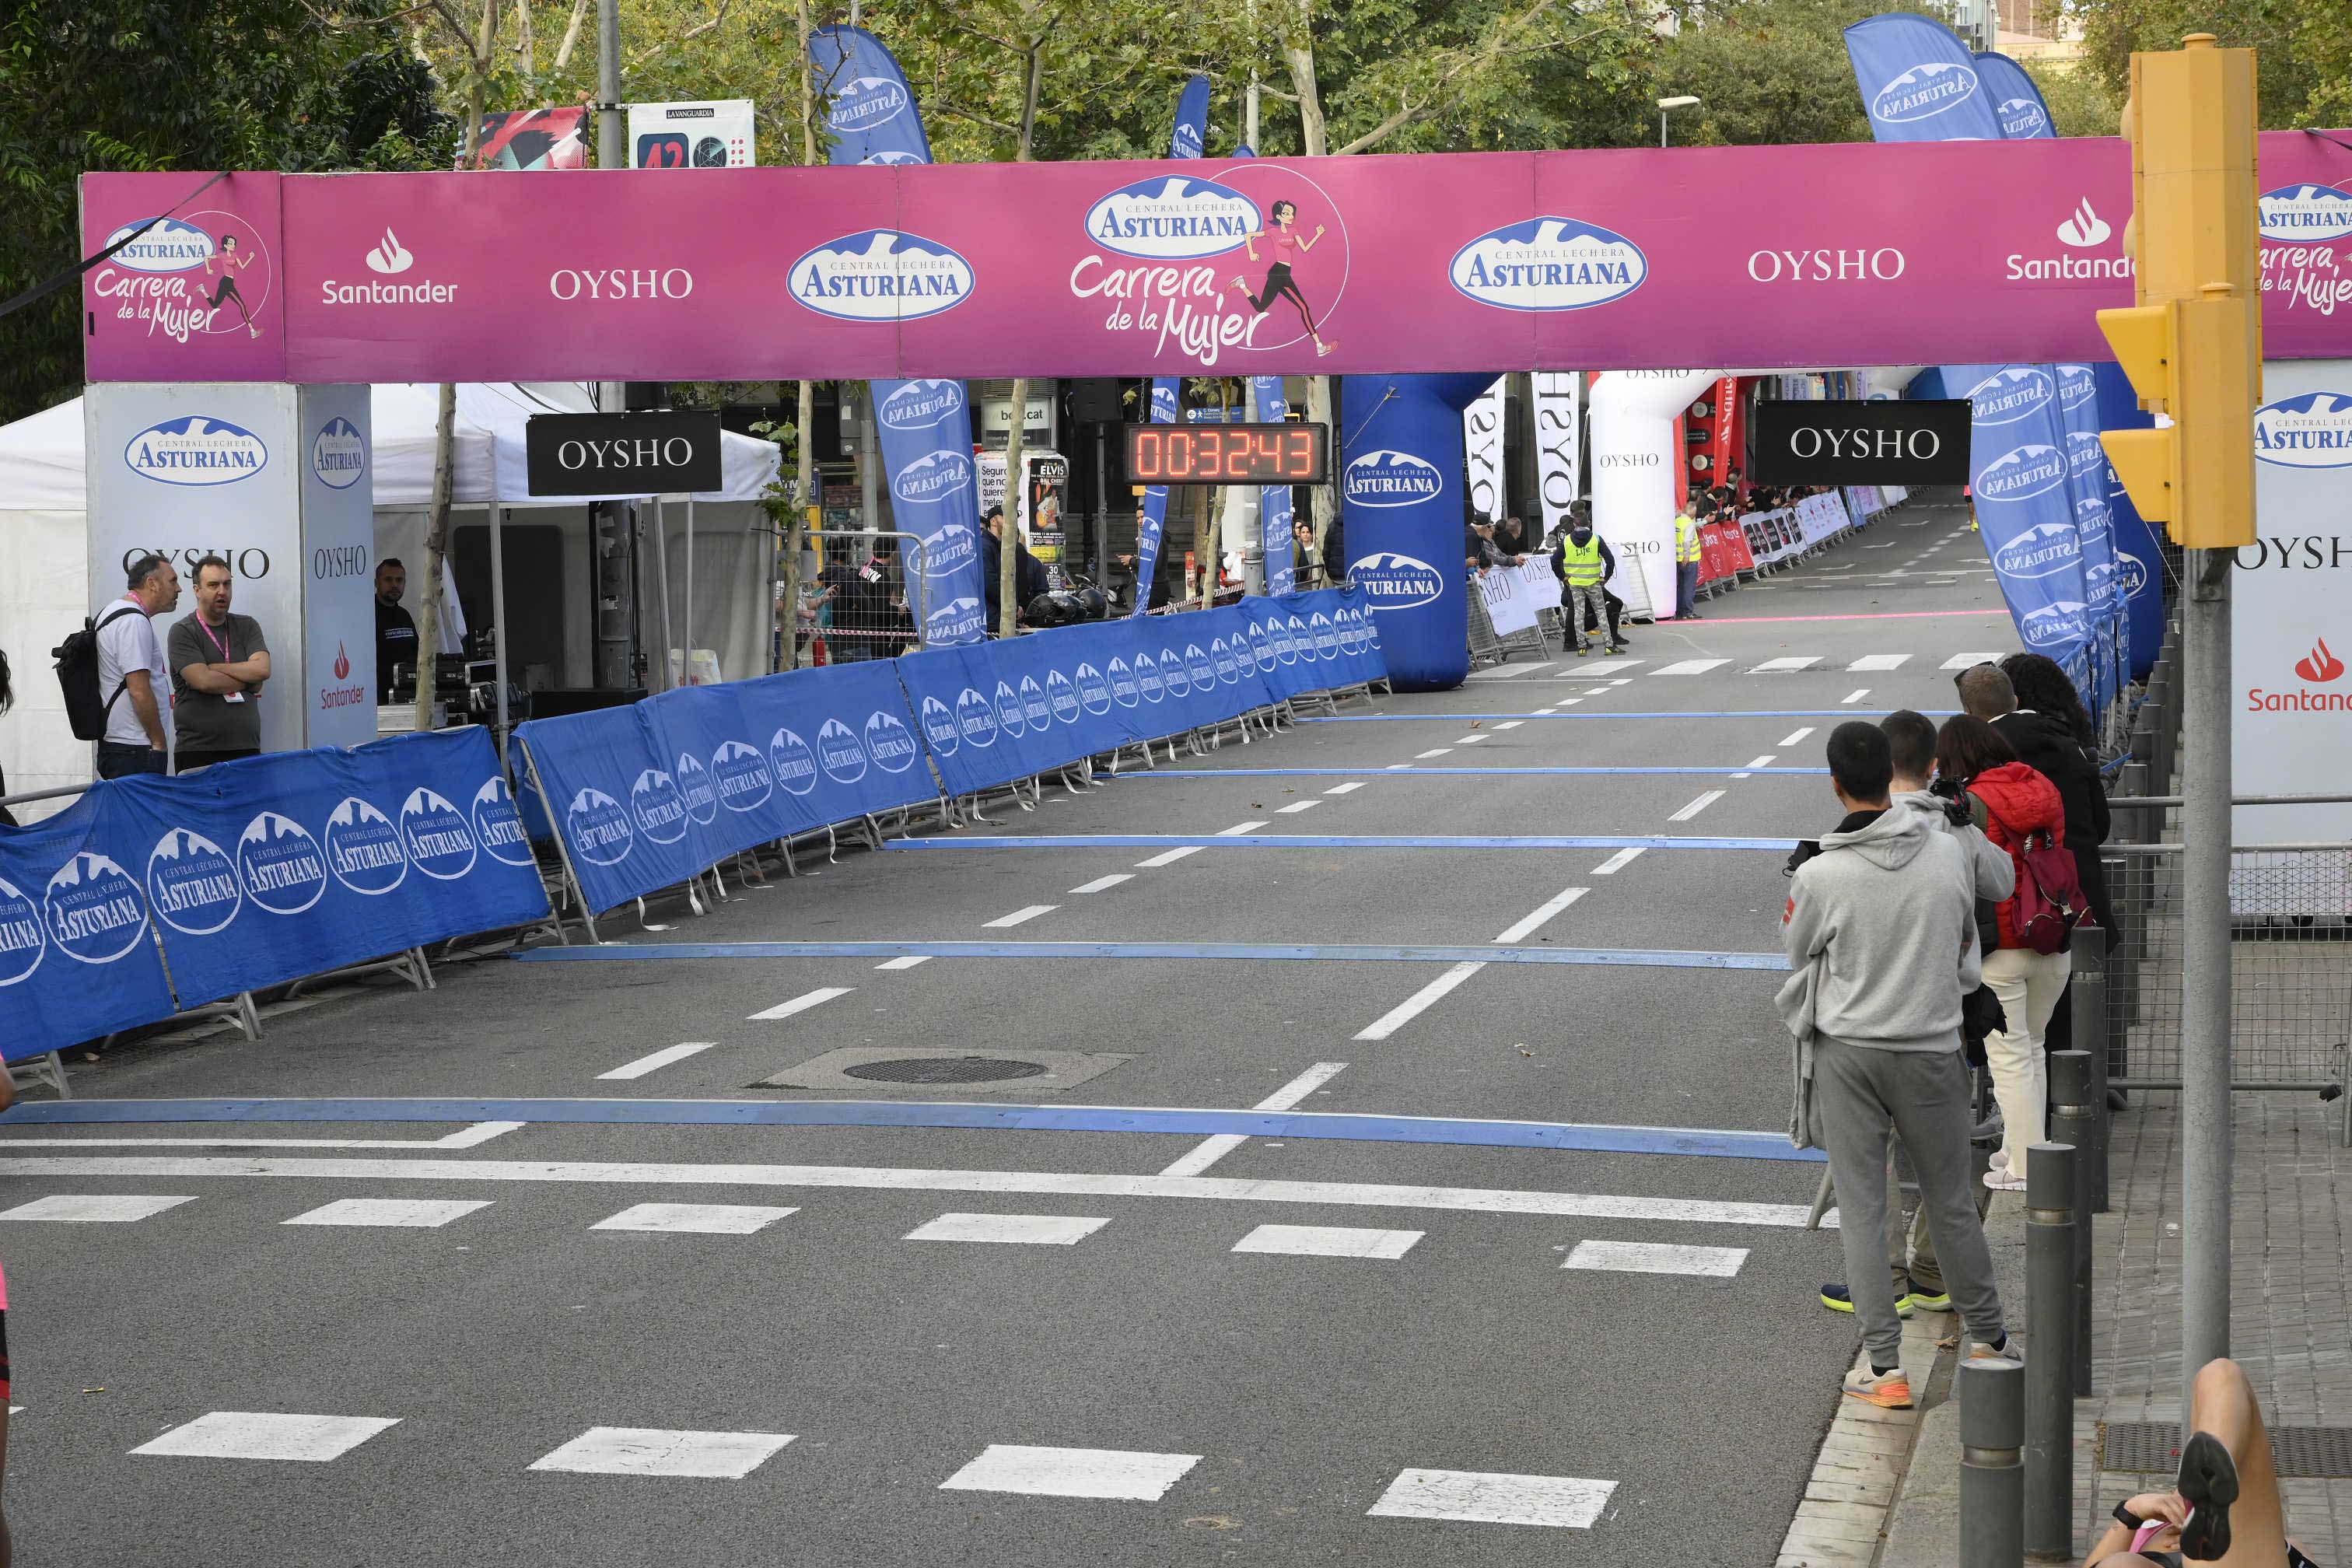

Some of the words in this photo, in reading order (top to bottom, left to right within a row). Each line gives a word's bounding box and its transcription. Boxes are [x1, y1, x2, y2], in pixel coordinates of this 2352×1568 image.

[1099, 207, 1247, 238] ASTURIANA
[1125, 205, 1183, 213] CENTRAL
[114, 236, 206, 258] ASTURIANA
[1495, 250, 1556, 259] CENTRAL
[1563, 249, 1625, 257] LECHERA
[2259, 247, 2334, 269] arrera
[831, 261, 889, 271] CENTRAL
[895, 261, 954, 270] LECHERA
[1069, 254, 1215, 299] Carrera
[1465, 254, 1632, 287] ASTURIANA
[1748, 247, 1905, 282] OYSHO
[2007, 254, 2136, 280] Santand
[94, 268, 186, 298] Carrera
[322, 279, 457, 304] Santander
[550, 268, 693, 300] OYSHO
[802, 264, 961, 297] ASTURIANA
[2277, 270, 2291, 291] la
[2288, 264, 2352, 316] Muje
[117, 299, 134, 319] de
[138, 299, 150, 320] la
[148, 295, 221, 343] Mujer
[1106, 301, 1132, 331] de
[1139, 299, 1158, 331] la
[1154, 292, 1270, 366] Mujer
[2255, 422, 2352, 450] ASTURIA
[2276, 418, 2329, 427] CENTRAL
[136, 442, 258, 468] ASTURIANA
[558, 437, 693, 470] OYSHO
[1138, 432, 1311, 476] 00:32:43
[1790, 427, 1940, 460] OYSHO
[317, 444, 362, 471] ASTURIANA
[1040, 465, 1064, 475] ELVIS
[1600, 453, 1659, 468] OYSHO
[982, 478, 994, 487] que
[1347, 473, 1435, 495] ASTURIANA
[1624, 541, 1661, 555] SHO
[2233, 536, 2352, 570] OYSH
[314, 545, 366, 579] OYSHO
[1048, 566, 1059, 575] 30
[1351, 576, 1436, 596] TURIANA
[321, 684, 365, 710] Santander
[2248, 688, 2352, 712] Santan
[775, 755, 815, 782] ASTURIANA
[821, 745, 865, 770] ASTURIANA
[716, 767, 771, 798] ASTURIANA
[413, 819, 438, 831] CENTRAL
[439, 815, 460, 827] LECHERA
[479, 813, 526, 847] ASTUR
[254, 845, 282, 860] CENTRAL
[282, 841, 311, 854] LECHERA
[333, 833, 404, 874] ASTURIANA
[408, 824, 473, 860] ASTURIANA
[165, 865, 196, 879] CENTRAL
[196, 859, 226, 874] LECHERA
[246, 855, 324, 894] ASTURIANA
[156, 871, 238, 915] ASTURIANA
[0, 903, 26, 915] ECHERA
